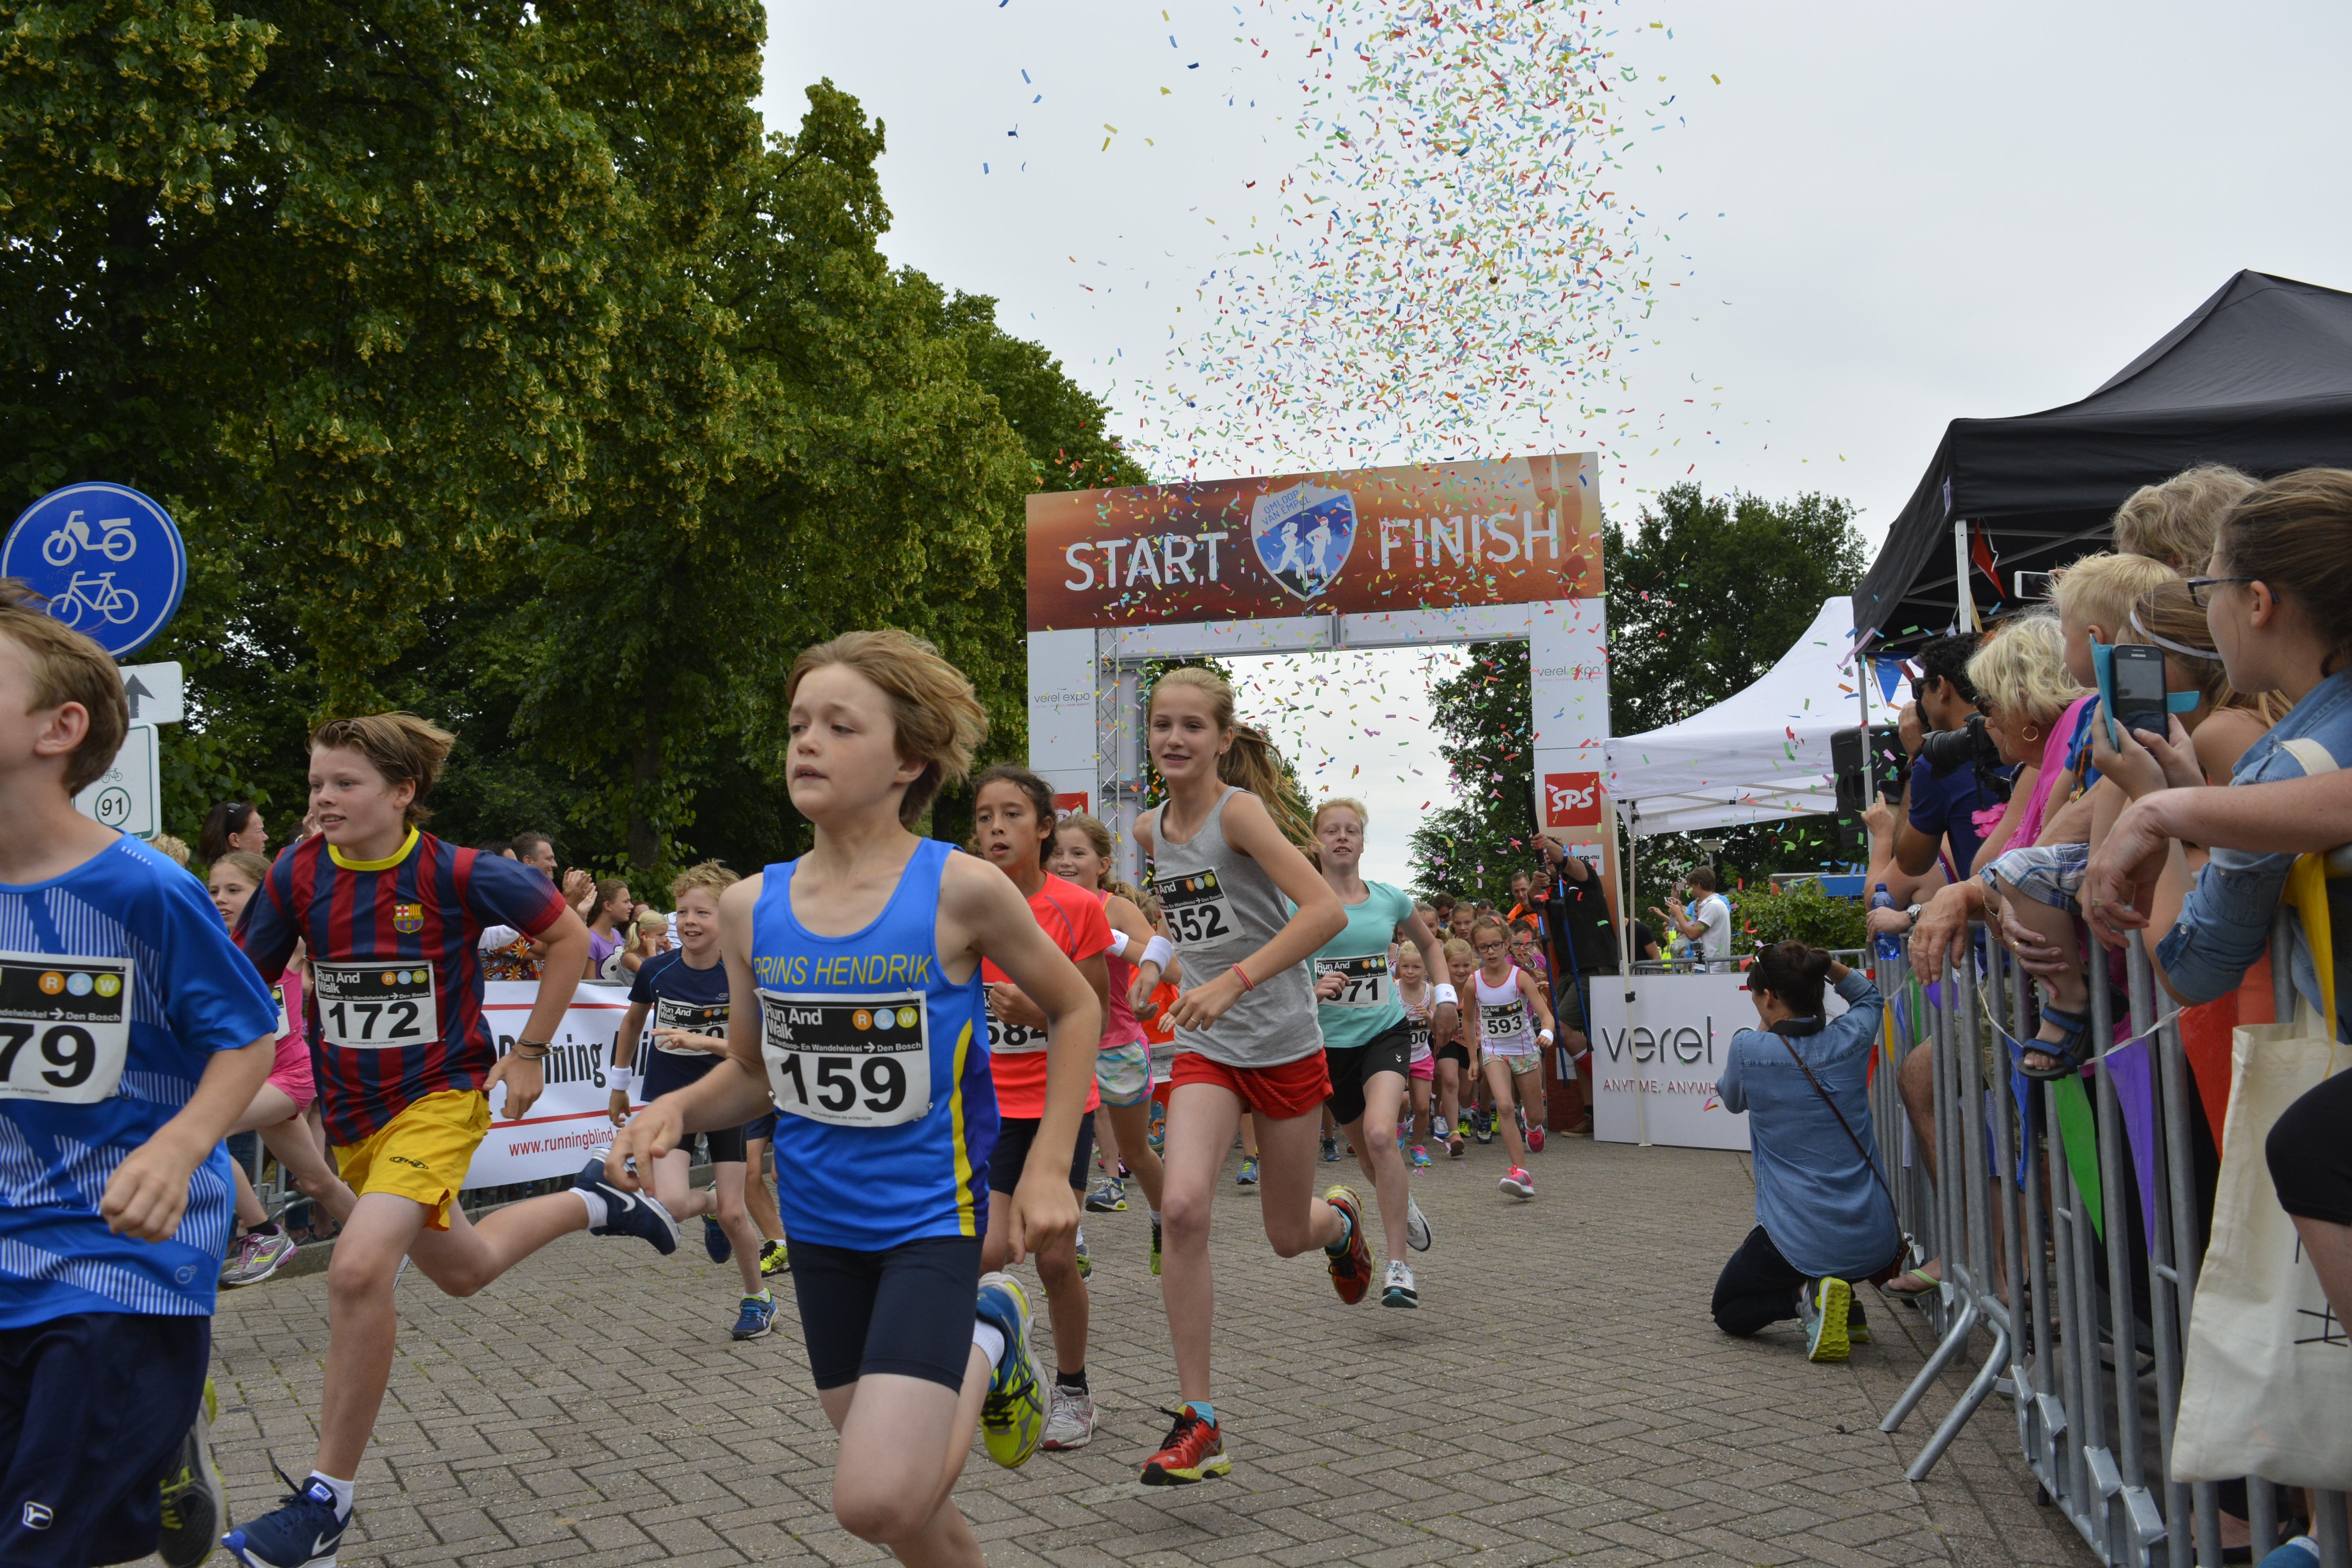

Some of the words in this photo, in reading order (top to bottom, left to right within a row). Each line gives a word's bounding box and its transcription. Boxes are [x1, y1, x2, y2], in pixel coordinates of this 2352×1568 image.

[1261, 510, 1280, 525] VAN
[1281, 496, 1311, 514] EMPEL
[1263, 490, 1298, 514] OMLOOP
[1065, 532, 1228, 591] START
[1379, 509, 1558, 570] FINISH
[1538, 666, 1566, 676] verel
[1570, 666, 1600, 676] expo
[1034, 693, 1060, 702] verel
[1063, 693, 1090, 702] expo
[102, 797, 122, 816] 91
[1552, 786, 1595, 812] SPS
[1159, 882, 1177, 894] And
[1164, 904, 1230, 943] 552
[317, 970, 334, 982] Run
[336, 972, 360, 983] And
[753, 955, 808, 985] PRINS
[814, 955, 933, 985] HENDRIK
[46, 977, 58, 989] R
[74, 978, 85, 990] &
[100, 980, 116, 992] W
[318, 980, 340, 993] Walk
[1325, 978, 1378, 1002] 71
[65, 1011, 86, 1020] Den
[328, 1001, 420, 1039] 172
[660, 1011, 677, 1022] Walk
[661, 1004, 674, 1014] Run
[675, 1007, 691, 1016] And
[764, 1001, 786, 1023] Run
[789, 1008, 822, 1025] And
[857, 1014, 867, 1025] R
[880, 1013, 889, 1025] &
[900, 1012, 914, 1023] W
[766, 1017, 794, 1040] Walk
[1487, 1015, 1522, 1034] 593
[811, 1044, 862, 1052] Wandelwinkel
[895, 1042, 921, 1051] Bosch
[1411, 1031, 1427, 1044] 00
[1602, 1016, 1713, 1063] verel
[0, 1022, 96, 1087] 79
[499, 1034, 606, 1088] ning
[780, 1053, 907, 1113] 159
[1603, 1079, 1661, 1093] ANYTME,
[1667, 1081, 1719, 1094] ANYWH
[509, 1127, 622, 1157] www.runningblind
[314, 1486, 329, 1497] NIKE
